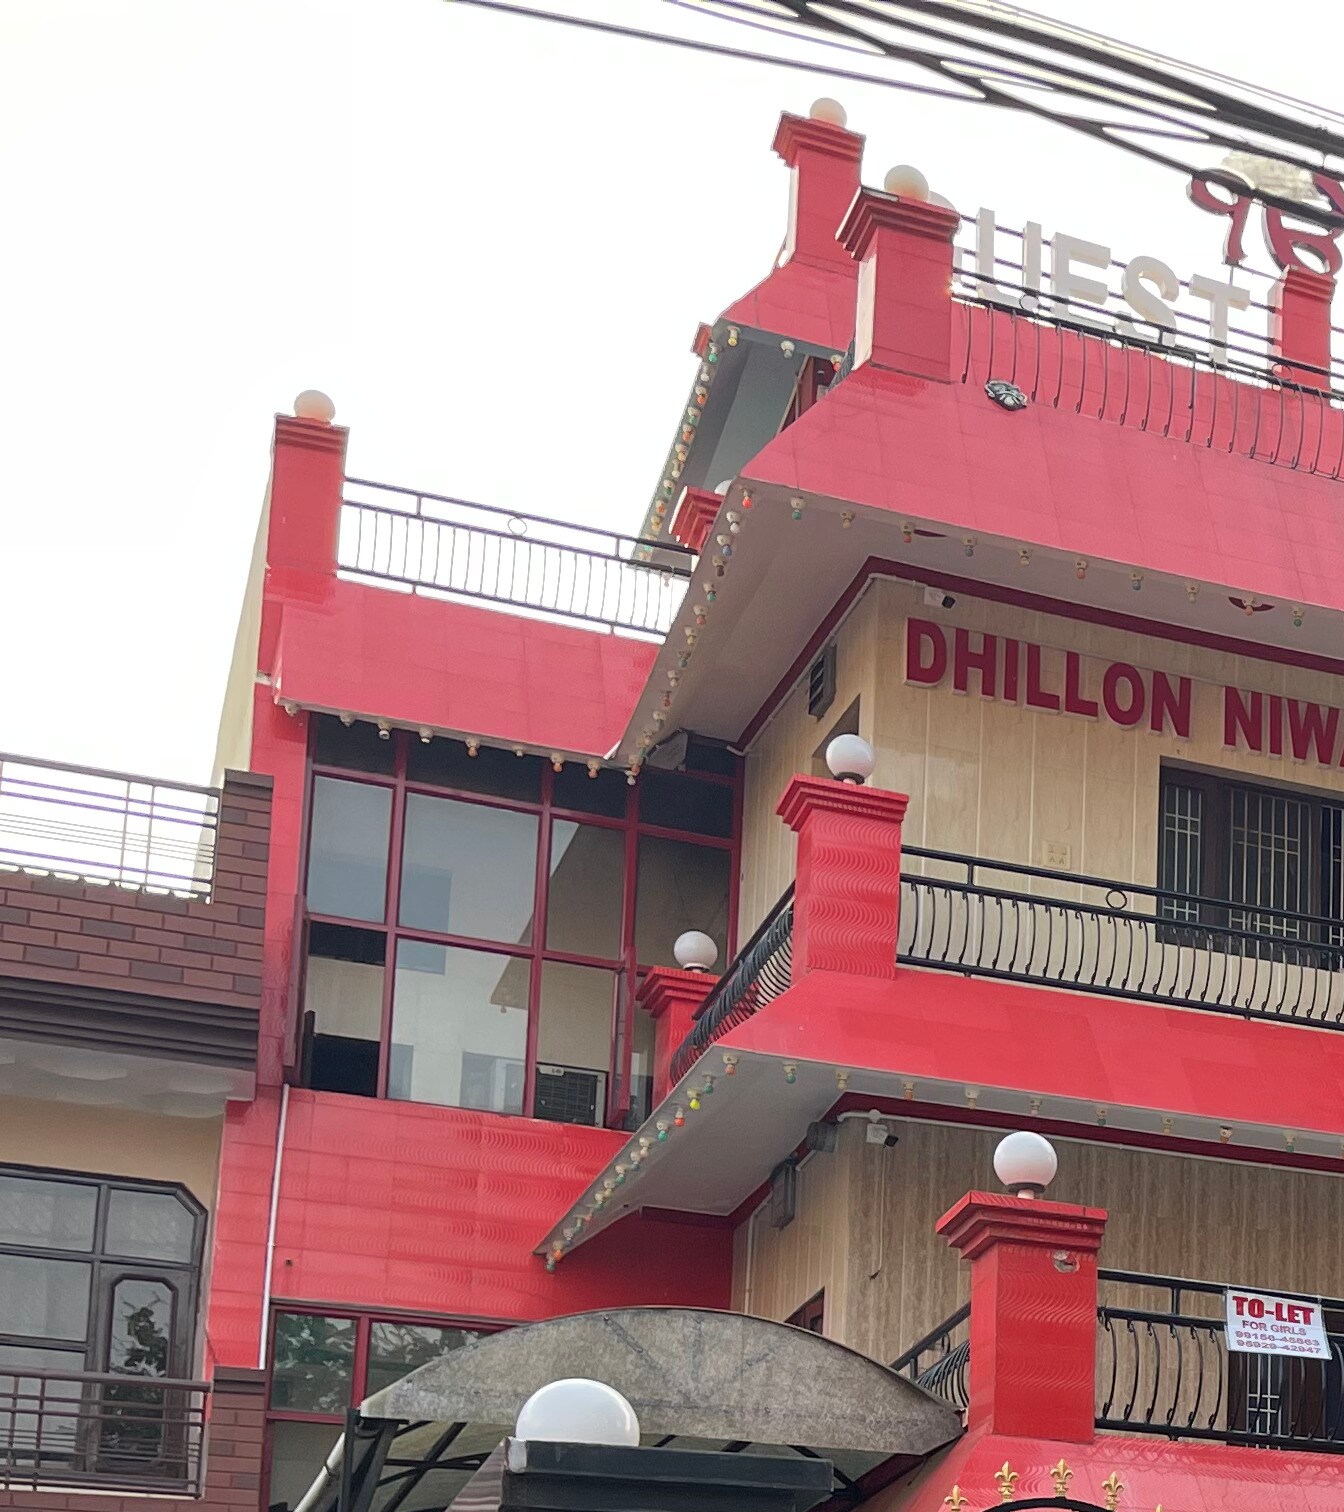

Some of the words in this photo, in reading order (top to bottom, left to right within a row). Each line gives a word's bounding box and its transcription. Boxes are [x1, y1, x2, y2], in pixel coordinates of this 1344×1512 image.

[953, 207, 1251, 363] UEST
[904, 617, 1192, 740] DHILLON
[1232, 1295, 1315, 1325] TO-LET
[1242, 1320, 1268, 1331] FOR
[1271, 1324, 1307, 1336] GIRLS
